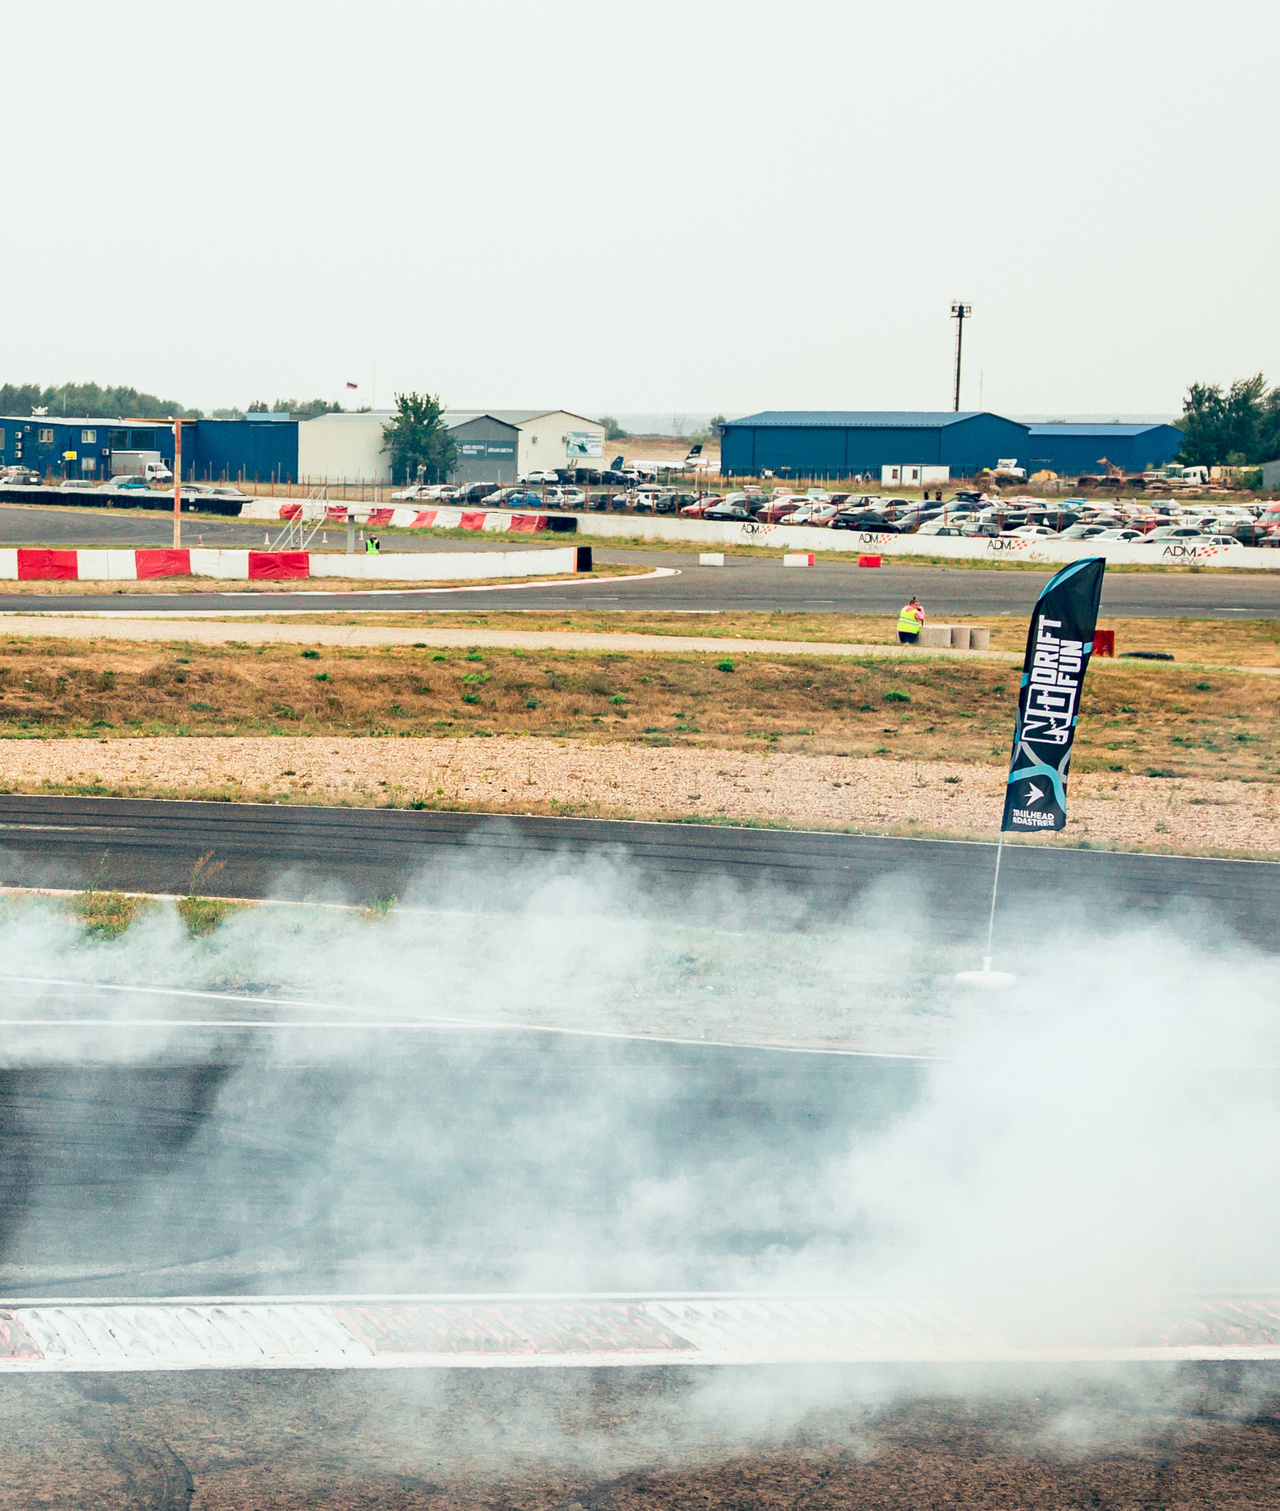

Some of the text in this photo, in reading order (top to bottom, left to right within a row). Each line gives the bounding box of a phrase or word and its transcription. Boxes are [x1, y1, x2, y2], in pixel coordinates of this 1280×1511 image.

[741, 523, 759, 534] ADM
[859, 533, 878, 544] ADM
[987, 540, 1011, 550] ADM
[1163, 546, 1196, 557] ADM
[1030, 615, 1061, 684] DRIFT
[1057, 640, 1082, 686] FUN
